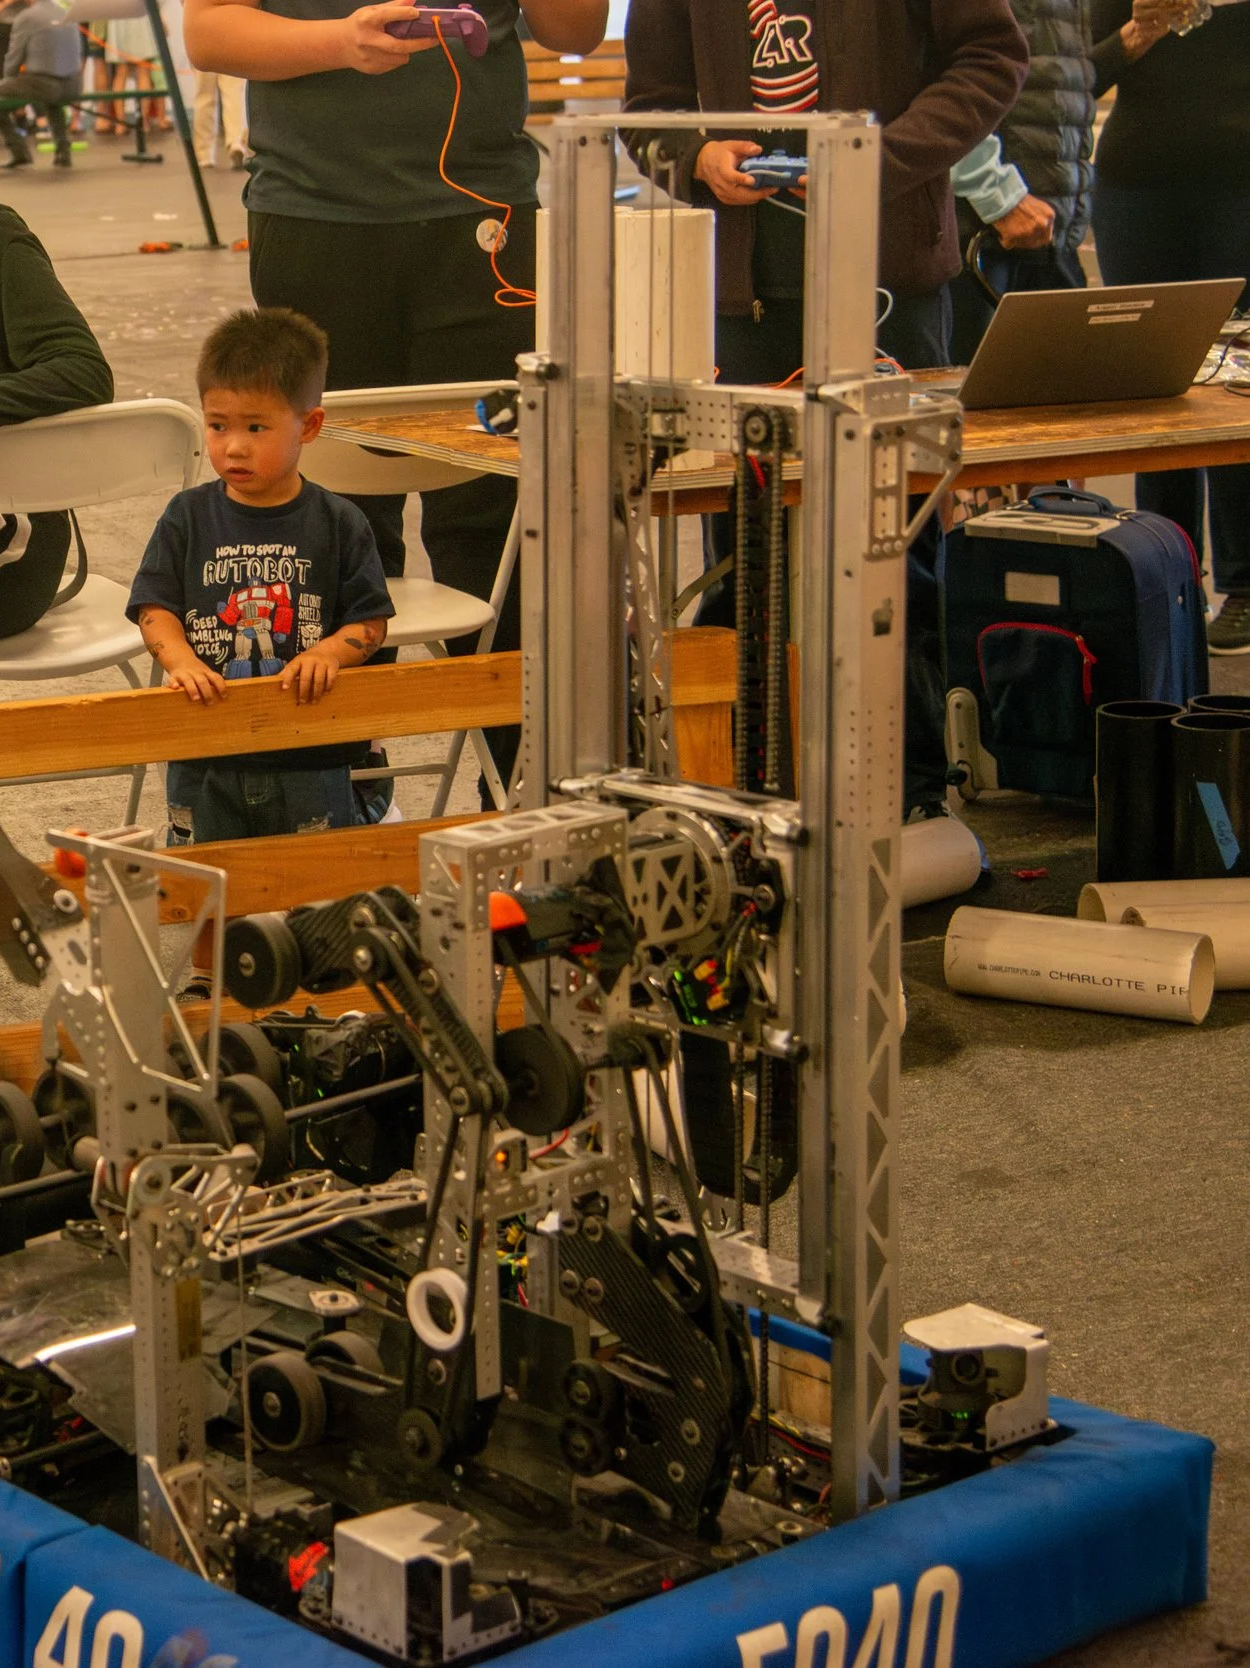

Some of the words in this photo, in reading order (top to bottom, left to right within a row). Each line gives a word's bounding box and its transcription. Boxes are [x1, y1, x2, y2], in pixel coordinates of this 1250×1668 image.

[216, 544, 240, 559] HOW
[241, 544, 256, 556] TO
[256, 543, 283, 556] SPOT
[282, 545, 297, 556] AN
[203, 557, 312, 586] AUTOBOT
[298, 605, 321, 622] SHIELD
[192, 615, 218, 630] DEEP
[188, 628, 233, 643] MBLING
[1049, 970, 1146, 991] CHARLOTTE
